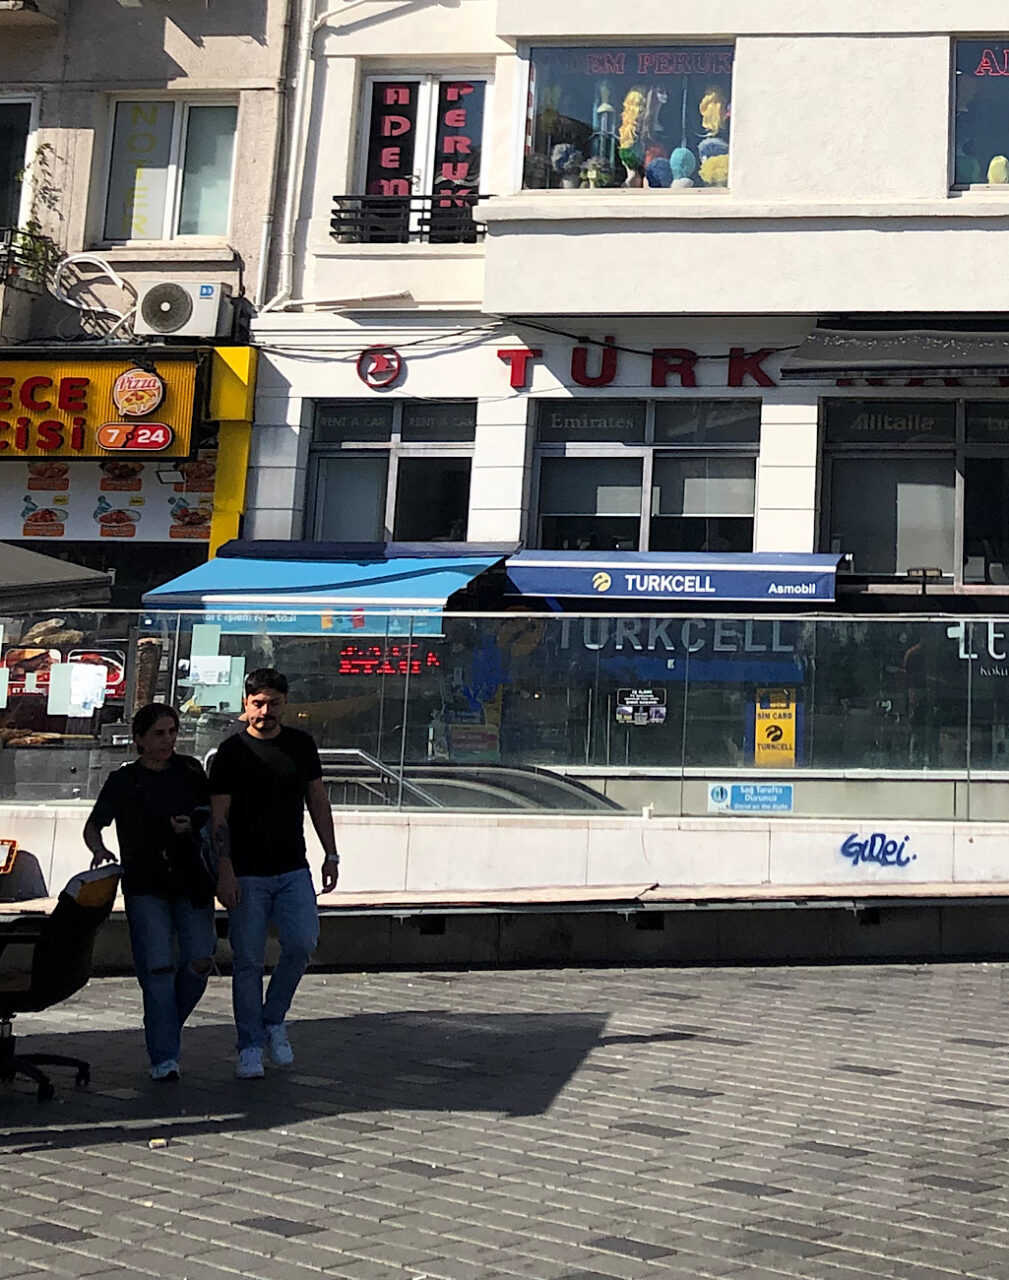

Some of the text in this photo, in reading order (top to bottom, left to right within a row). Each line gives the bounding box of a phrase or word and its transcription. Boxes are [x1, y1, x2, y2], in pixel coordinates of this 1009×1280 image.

[638, 53, 732, 74] PERUK
[375, 84, 412, 197] ADEM
[439, 82, 474, 208] PERUK
[497, 335, 779, 389] TÜRK
[118, 376, 160, 391] Pizza
[551, 413, 635, 430] Emirates
[850, 412, 936, 431] Alitalia
[137, 429, 165, 443] 24
[624, 574, 716, 593] TURKCELL
[767, 581, 816, 595] Asmobil
